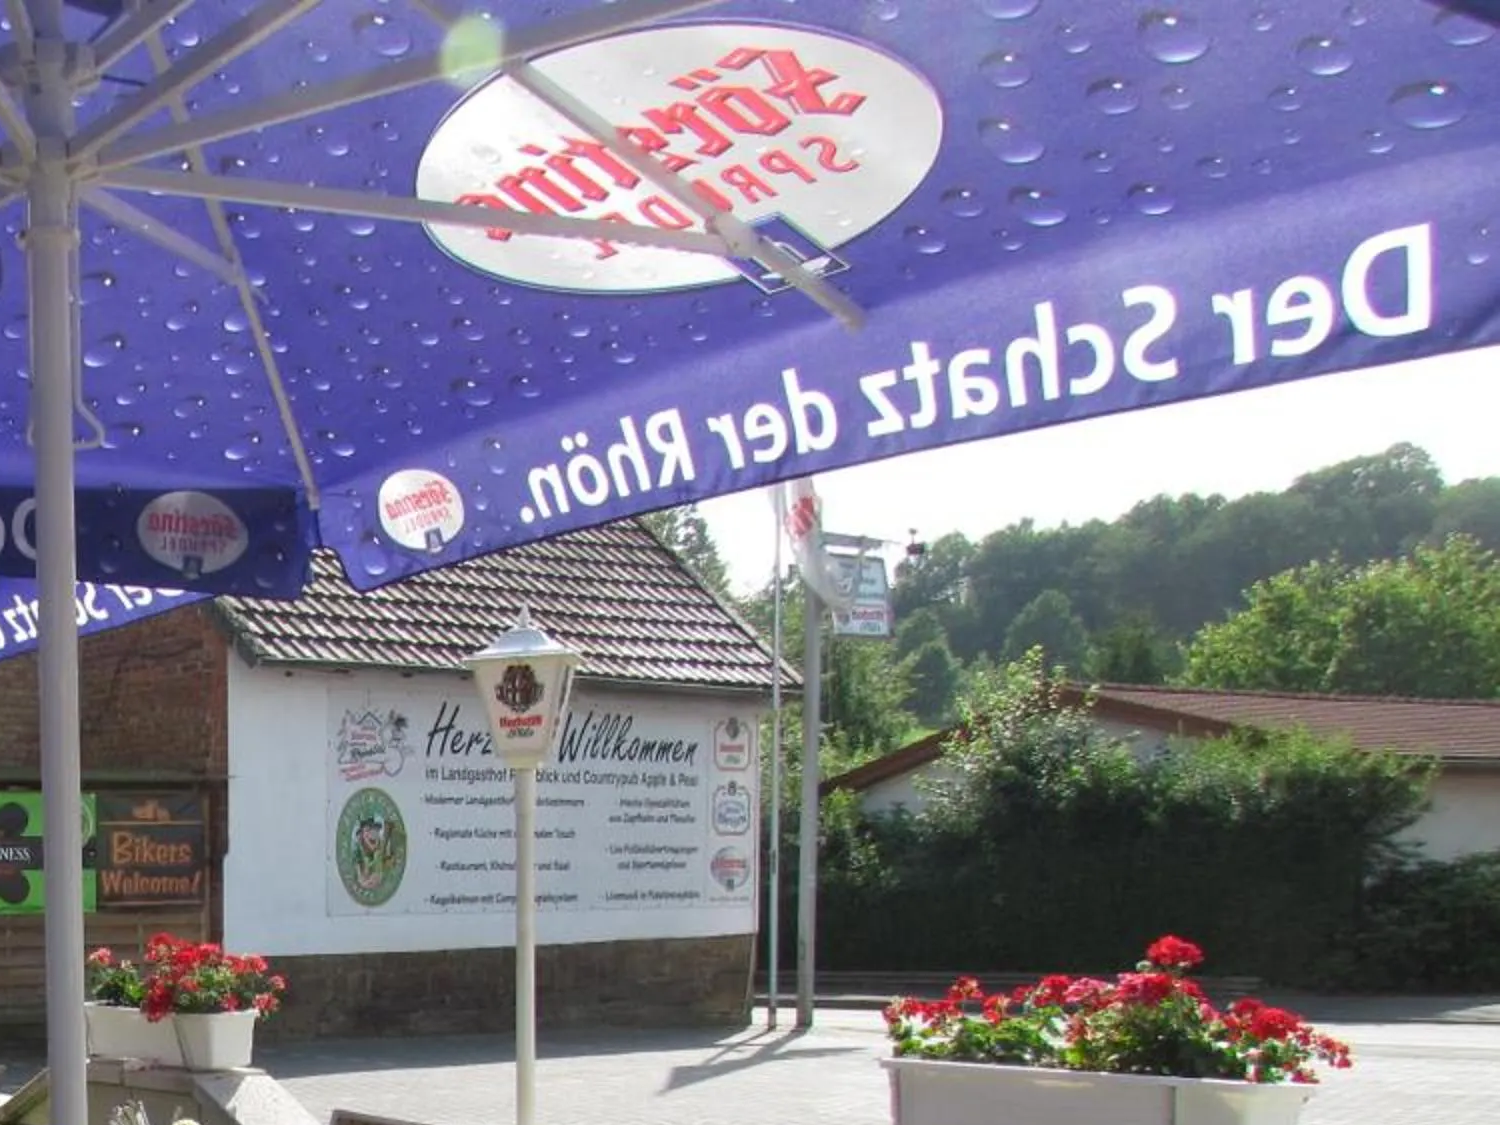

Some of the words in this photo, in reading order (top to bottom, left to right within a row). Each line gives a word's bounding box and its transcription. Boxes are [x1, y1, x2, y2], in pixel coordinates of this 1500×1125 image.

[425, 701, 492, 757] Herz
[558, 710, 700, 766] Willkommen
[441, 766, 508, 785] Landgasthof
[562, 770, 581, 785] und
[111, 830, 193, 867] Bikers
[100, 869, 202, 896] Welcome!
